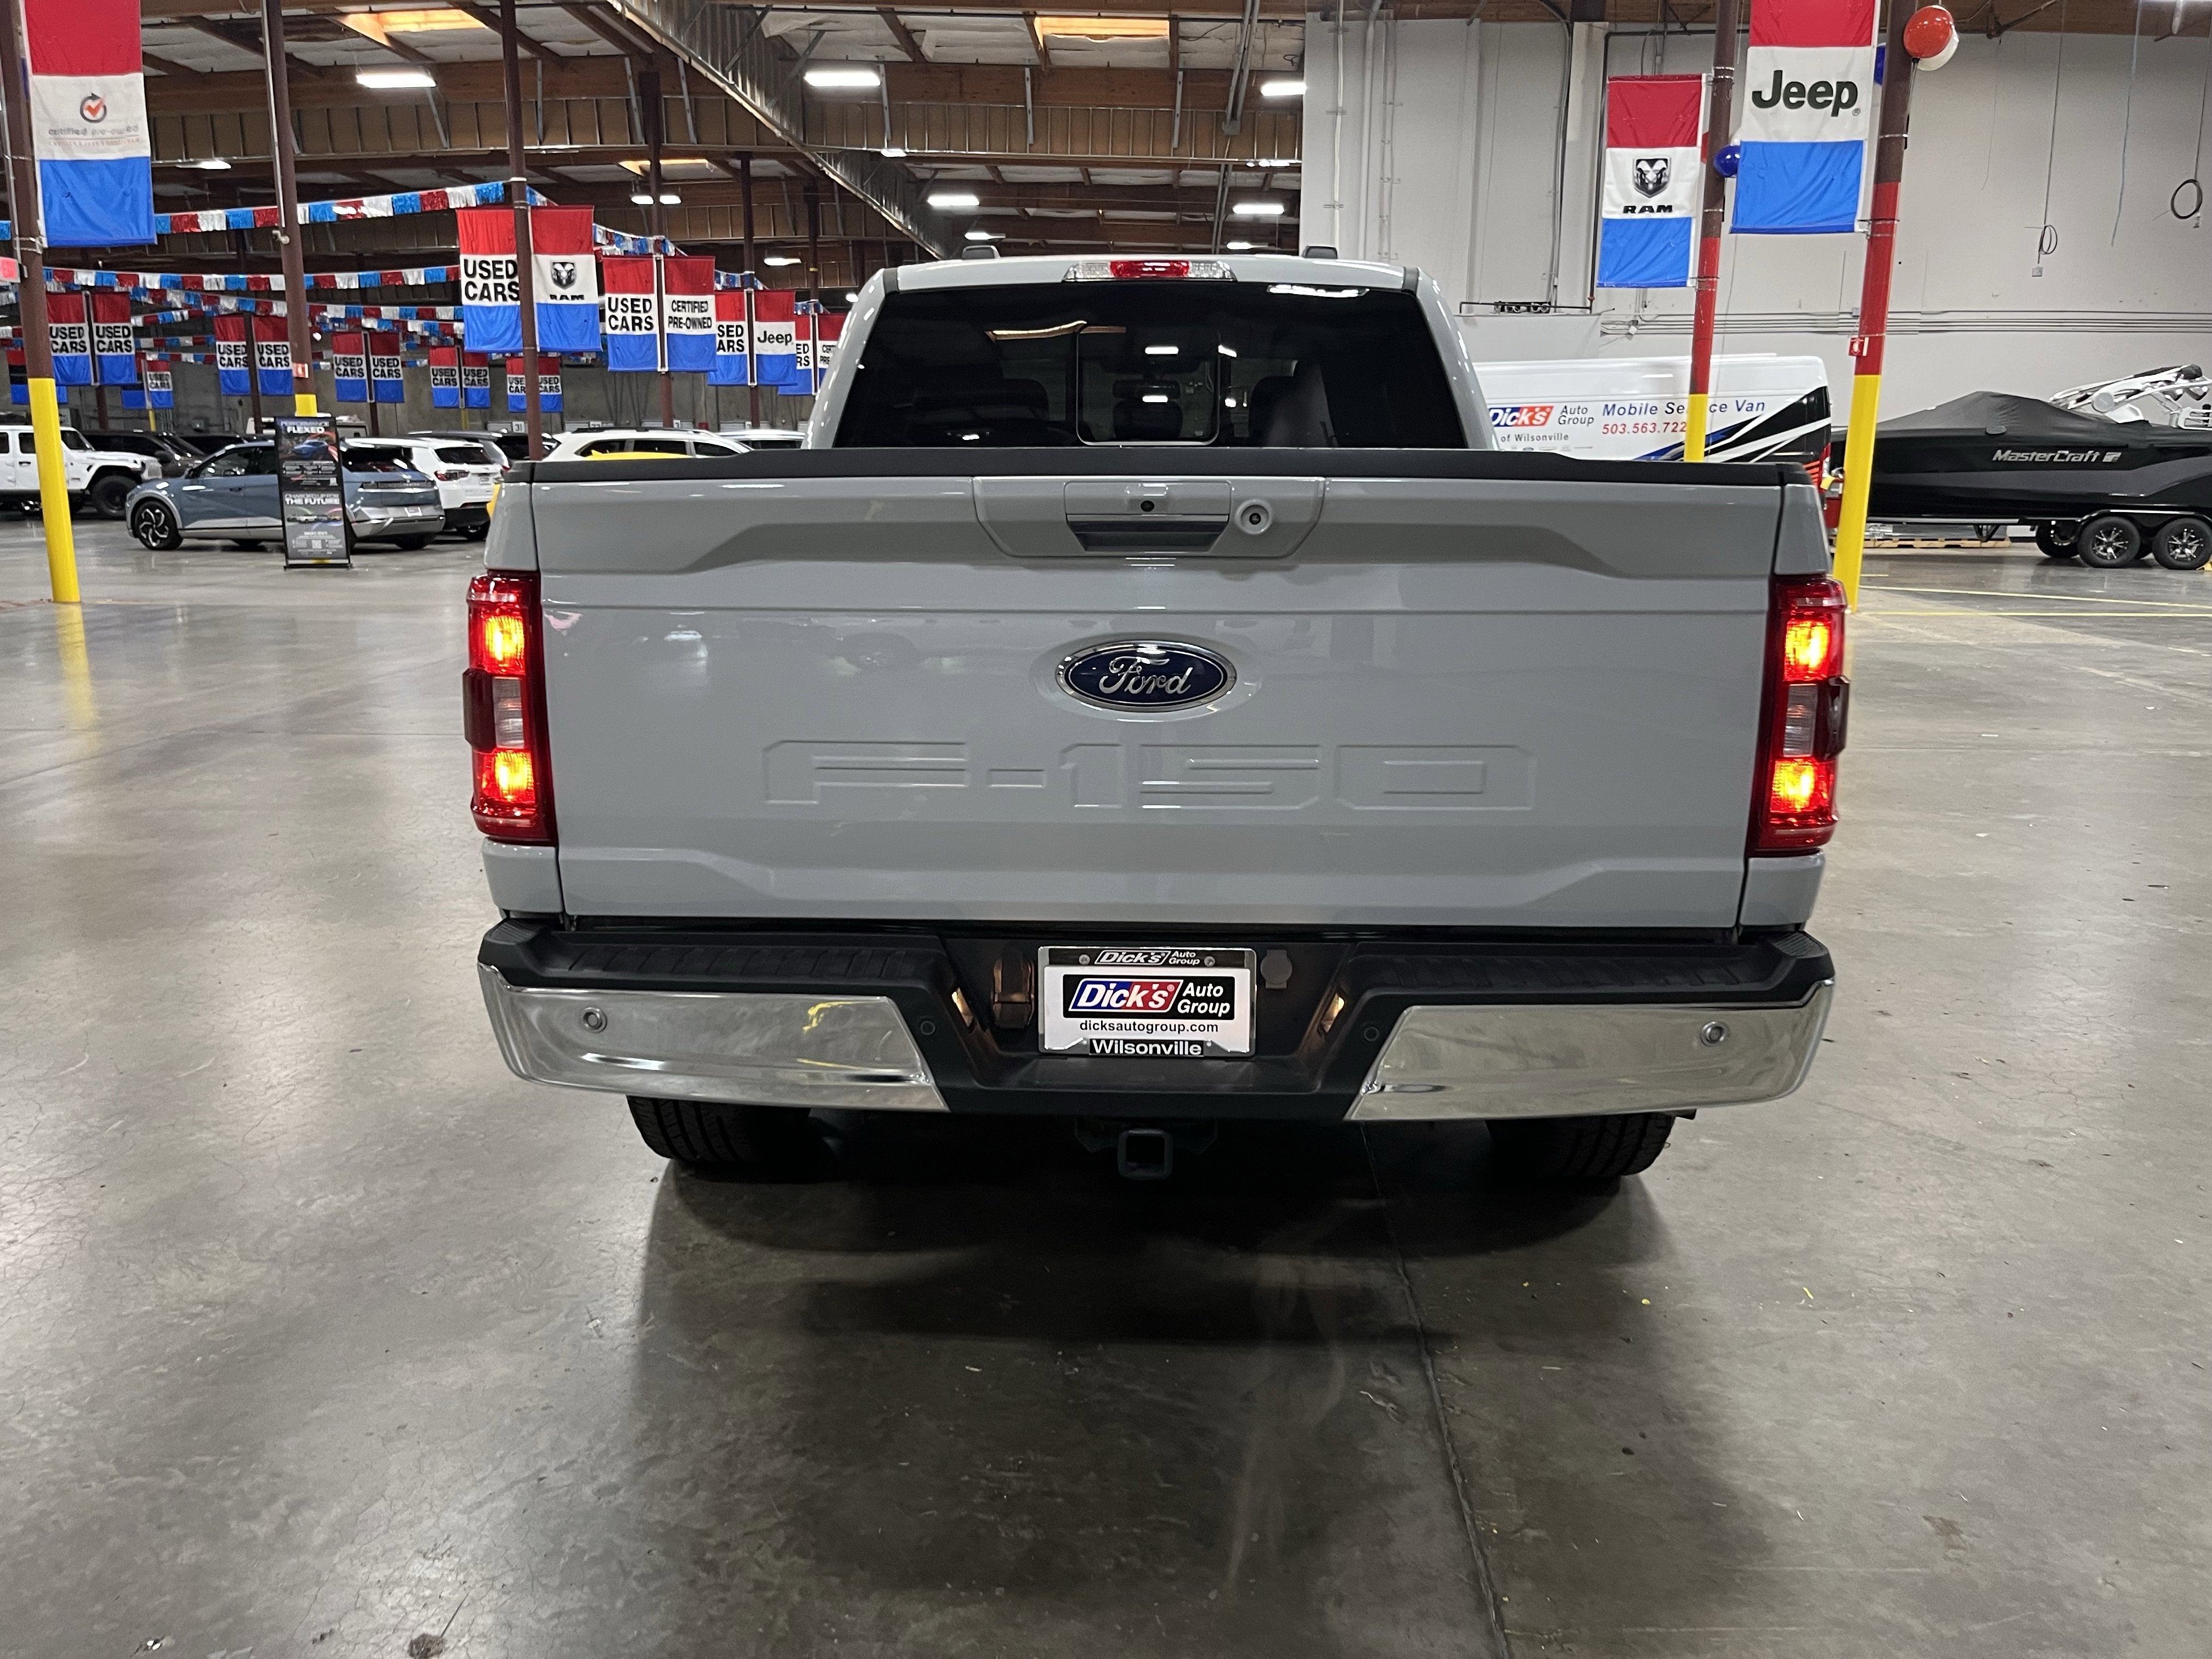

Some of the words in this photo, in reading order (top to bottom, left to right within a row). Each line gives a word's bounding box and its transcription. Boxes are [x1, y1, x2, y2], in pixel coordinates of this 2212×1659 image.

[1751, 70, 1859, 117] Jeep
[1622, 205, 1673, 213] RAM
[464, 259, 518, 279] USED
[464, 281, 520, 302] CARS
[608, 297, 652, 314] USED
[671, 300, 709, 313] CERTIFIED
[608, 314, 654, 331] CARS
[668, 316, 713, 329] PRE-OWNED
[49, 326, 84, 340] USED
[95, 325, 131, 338] USED
[717, 324, 744, 338] SED
[757, 330, 792, 346] Jeep
[51, 340, 87, 353] CARS
[97, 340, 132, 353] CARS
[218, 344, 247, 355] USED
[257, 344, 289, 355] USED
[716, 339, 745, 353] ARS
[219, 357, 249, 367] CARS
[259, 357, 290, 367] CARS
[335, 356, 363, 366] USED
[373, 358, 399, 368] USED
[336, 368, 364, 377] CARS
[373, 368, 401, 378] CARS
[432, 368, 456, 377] USED
[464, 368, 488, 377] USED
[432, 377, 458, 386] CARS
[509, 385, 526, 393] CAR
[1560, 405, 1588, 415] Auto
[1602, 403, 1658, 416] Mobile
[1735, 400, 1765, 412] Van
[1489, 407, 1548, 426] Dick's
[1558, 415, 1594, 427] Group
[1602, 421, 1687, 435] 503.563.722
[1500, 434, 1510, 442] of
[1515, 432, 1569, 442] Wilsonville
[1992, 449, 2101, 462] MasterCraft
[1099, 656, 1194, 694] Ford
[763, 739, 1534, 811] F-150
[1099, 951, 1162, 963] Dick's
[1169, 957, 1200, 966] Group
[1077, 983, 1170, 1008] Dick's
[1182, 982, 1224, 997] Auto
[1177, 999, 1231, 1017] Group
[1079, 1020, 1219, 1034] dicksautogroup.com
[1092, 1039, 1202, 1056] Wilsonville
